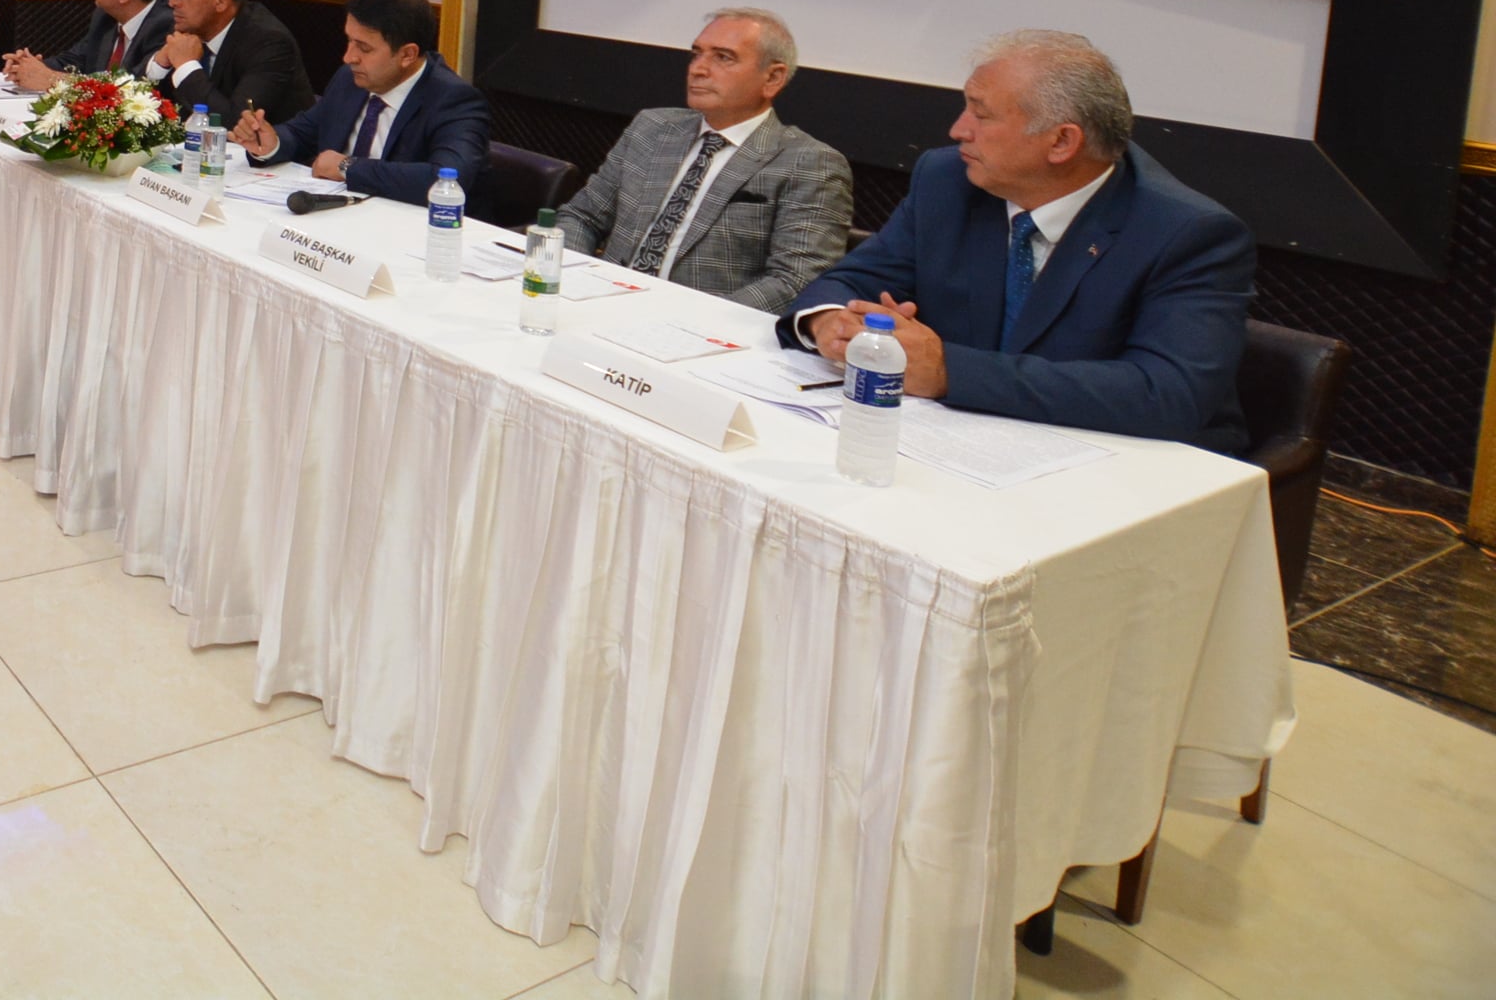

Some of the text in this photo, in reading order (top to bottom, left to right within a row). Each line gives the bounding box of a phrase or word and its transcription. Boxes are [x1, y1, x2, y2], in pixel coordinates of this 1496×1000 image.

[139, 176, 193, 207] DİVAN BAŞKANI
[280, 228, 356, 265] DİVAN BAŞKAN
[293, 250, 325, 272] VEKİLİ
[603, 368, 652, 396] KATİP
